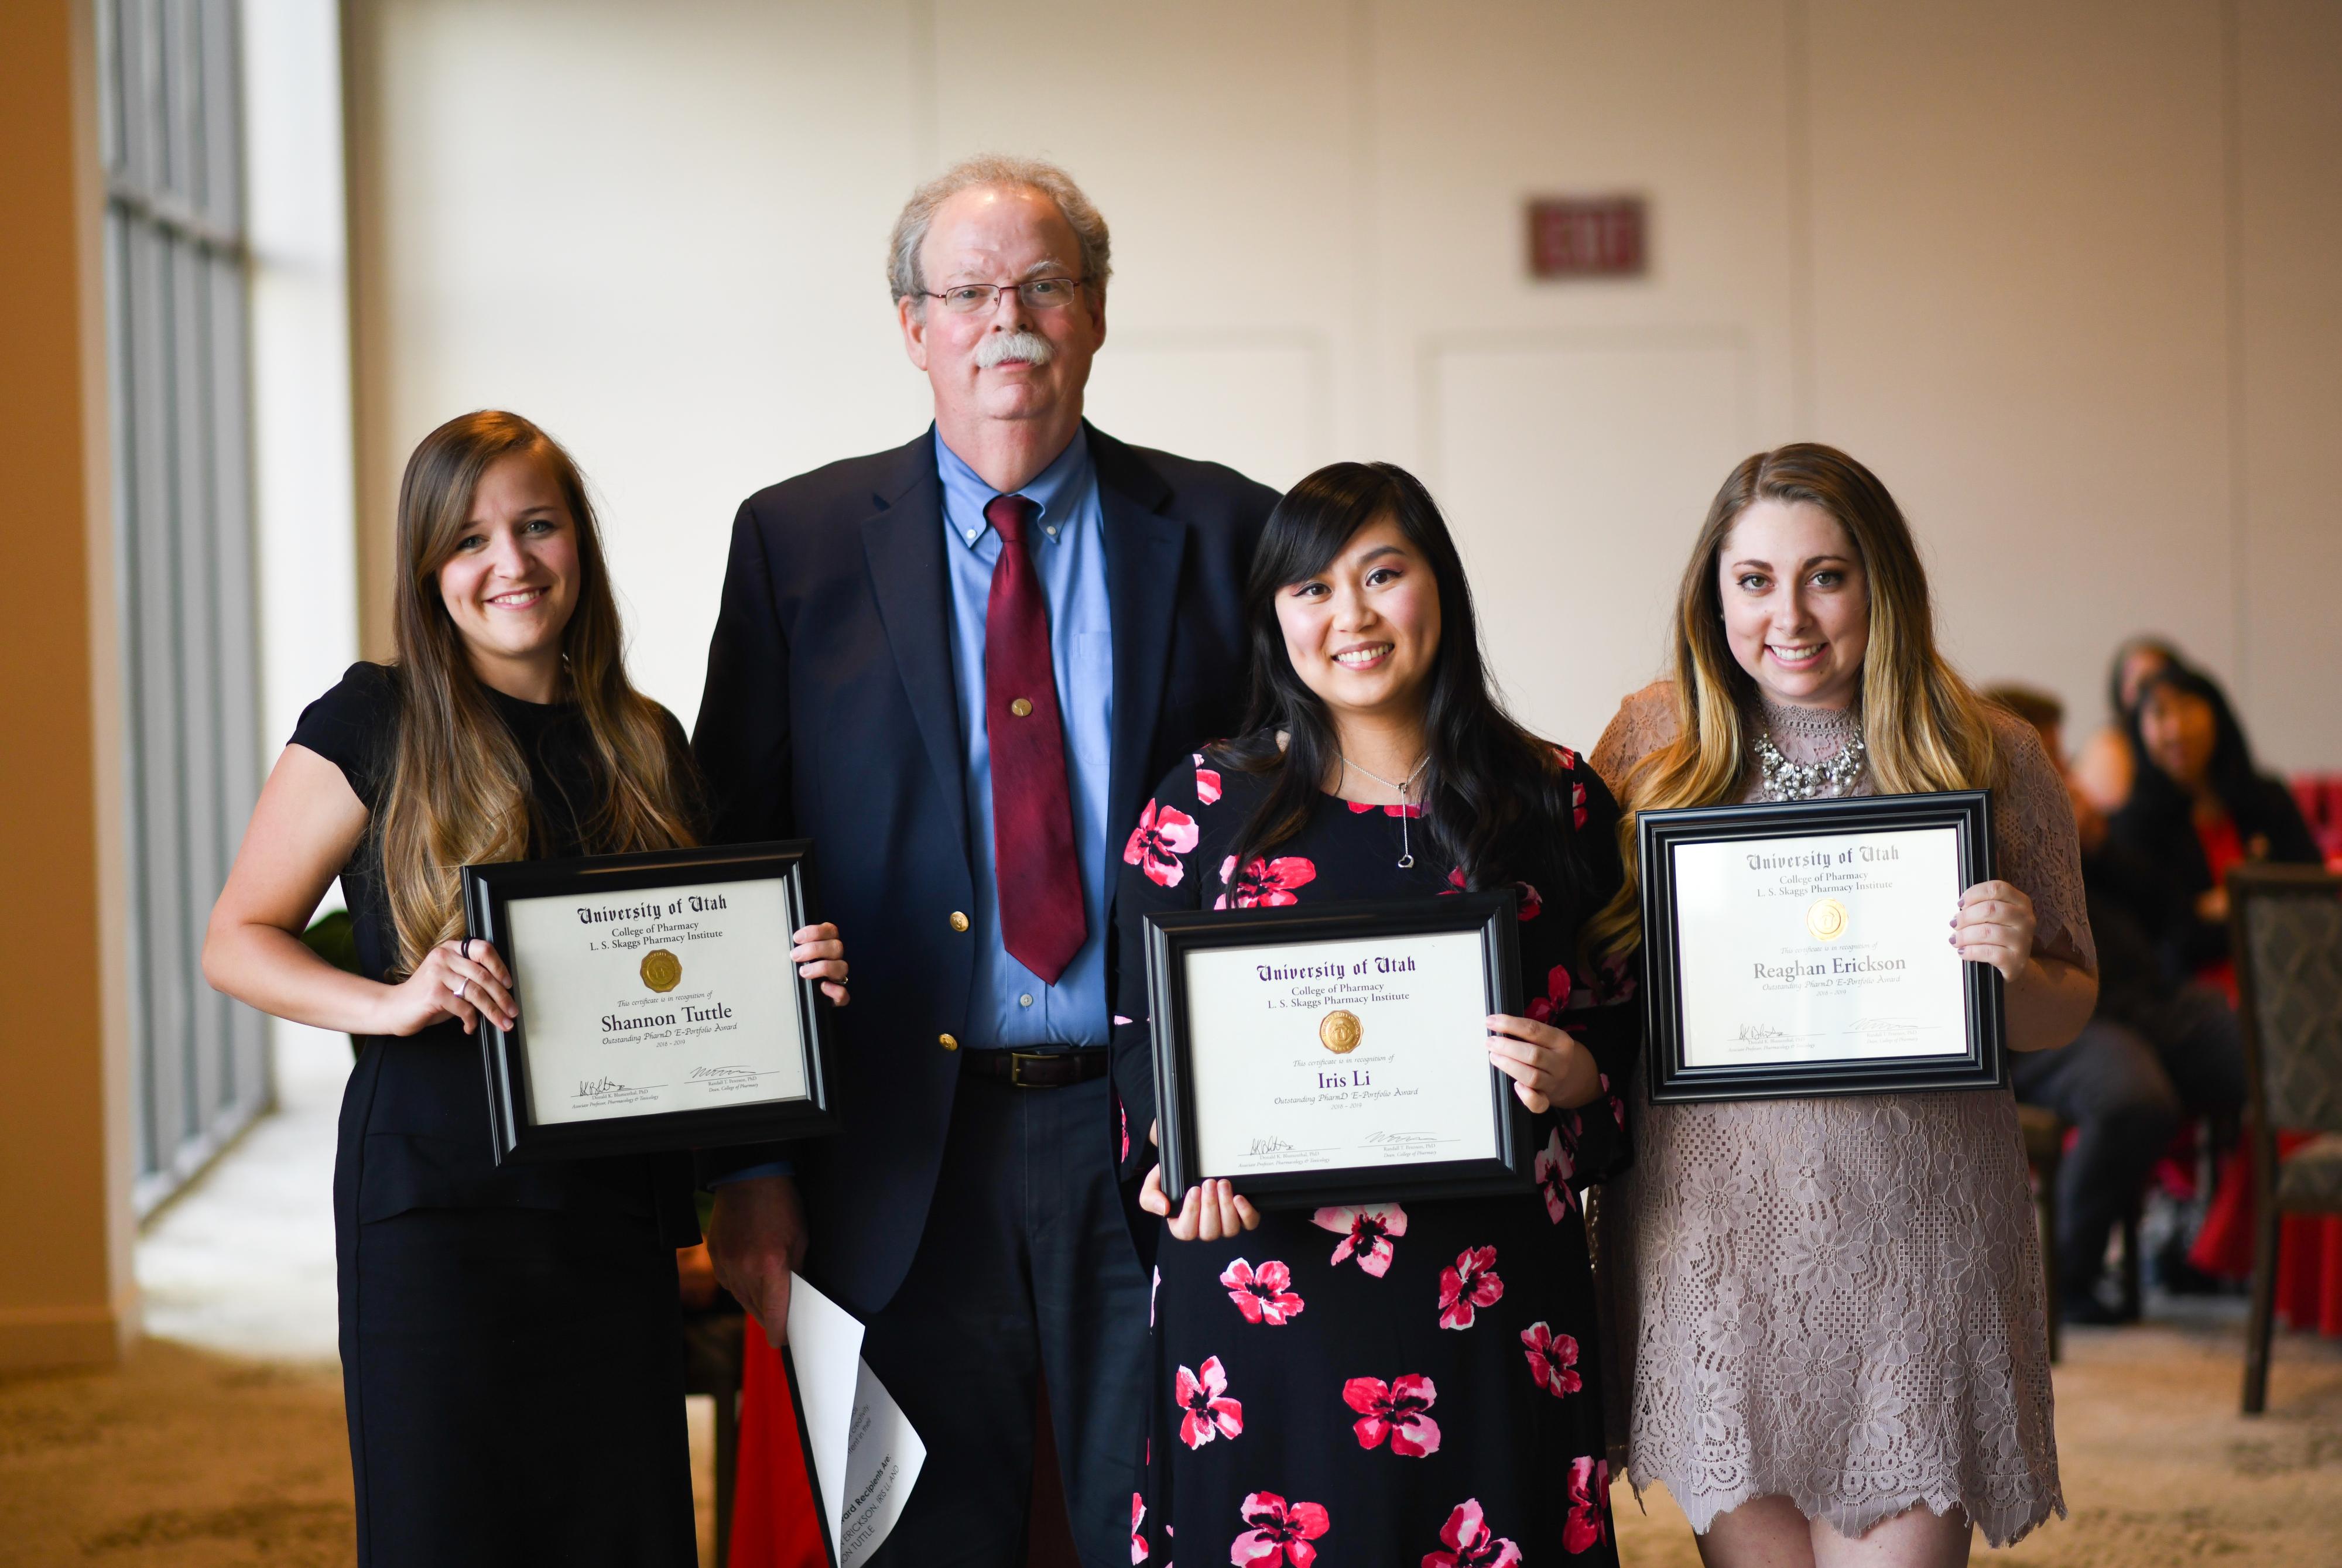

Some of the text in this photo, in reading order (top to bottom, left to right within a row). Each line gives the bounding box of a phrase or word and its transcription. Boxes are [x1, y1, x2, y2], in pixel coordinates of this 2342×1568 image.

[1746, 844, 1899, 871] University of Utah
[1779, 872, 1868, 885] College of Pharmacy
[1757, 881, 1893, 898] L. S. Skaggs Pharmacy Institute
[577, 894, 727, 925] University of Utah
[611, 922, 699, 937] College of Pharmacy
[590, 930, 723, 951] L. S. Skaggs Pharmacy Institute
[1256, 956, 1416, 982] University of Utah
[1754, 955, 1906, 982] Reaghan Erickson
[1292, 983, 1384, 997] College of Pharmacy
[1762, 974, 1901, 992] Outstanding PharmD E-Portfolio Award
[632, 997, 659, 1008] certificate
[675, 992, 705, 1002] recognition
[706, 990, 713, 1000] of
[1268, 992, 1409, 1009] L. S. Skaggs Pharmacy Institute
[601, 1002, 732, 1032] Shannon Tuttle
[602, 1022, 738, 1045] Outstanding PharmD E-Portfolio Award
[1293, 1059, 1306, 1067] This
[1308, 1058, 1337, 1068] certificate
[1354, 1056, 1386, 1065] recognition
[1388, 1053, 1395, 1063] of
[1318, 1070, 1370, 1088] Iris Li
[1274, 1087, 1419, 1105] Outstanding PharmD E-Portfolio Award
[855, 1470, 884, 1507] Recipients
[882, 1454, 892, 1471] Are:
[877, 1489, 886, 1504] IRIS
[889, 1465, 899, 1483] AND
[851, 1525, 875, 1550] TUTTLE
